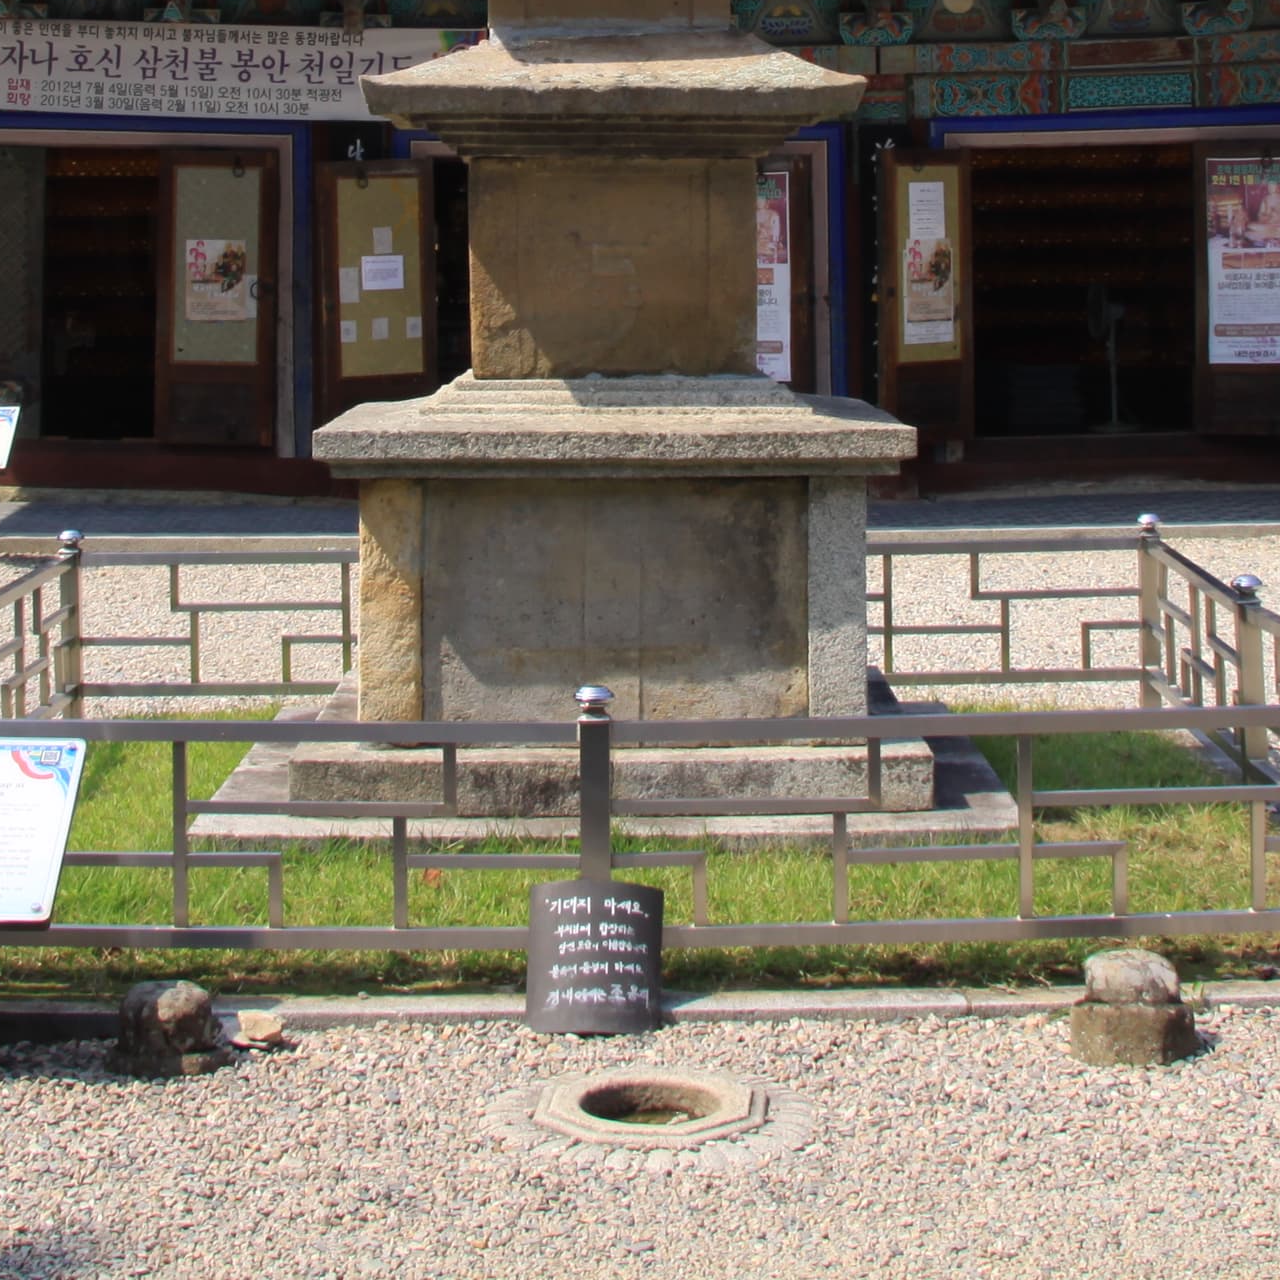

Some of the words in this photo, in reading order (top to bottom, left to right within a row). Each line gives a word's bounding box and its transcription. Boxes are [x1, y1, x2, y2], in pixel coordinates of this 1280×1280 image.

[13, 22, 33, 36] 좋은
[40, 23, 72, 37] 인연을
[77, 24, 99, 39] 부디
[104, 25, 138, 40] 놓치지
[143, 27, 177, 41] 마시고
[182, 28, 262, 44] 불자님들께서는
[267, 31, 289, 45] 많은
[65, 44, 122, 78] 호신
[133, 45, 223, 81] 삼천불
[230, 48, 290, 83] 봉안
[7, 78, 31, 91] 입재
[41, 80, 81, 95] 2012년
[86, 81, 105, 96] 7월
[108, 82, 156, 97] 4일(음력
[160, 84, 179, 98] 5월
[184, 85, 214, 100] 15일)
[218, 86, 241, 100] 오전
[247, 87, 271, 101] 10시
[276, 88, 302, 101] 30분
[307, 88, 343, 102] 적광전
[40, 94, 81, 109] 2015년
[85, 95, 105, 110] 3월
[108, 96, 163, 112] 30일(음력
[167, 98, 186, 113] 2월
[192, 99, 221, 114] 11일)
[225, 100, 249, 115] 오전
[255, 101, 279, 116] 10시
[283, 102, 310, 116] 30분
[549, 896, 591, 915] 기대지
